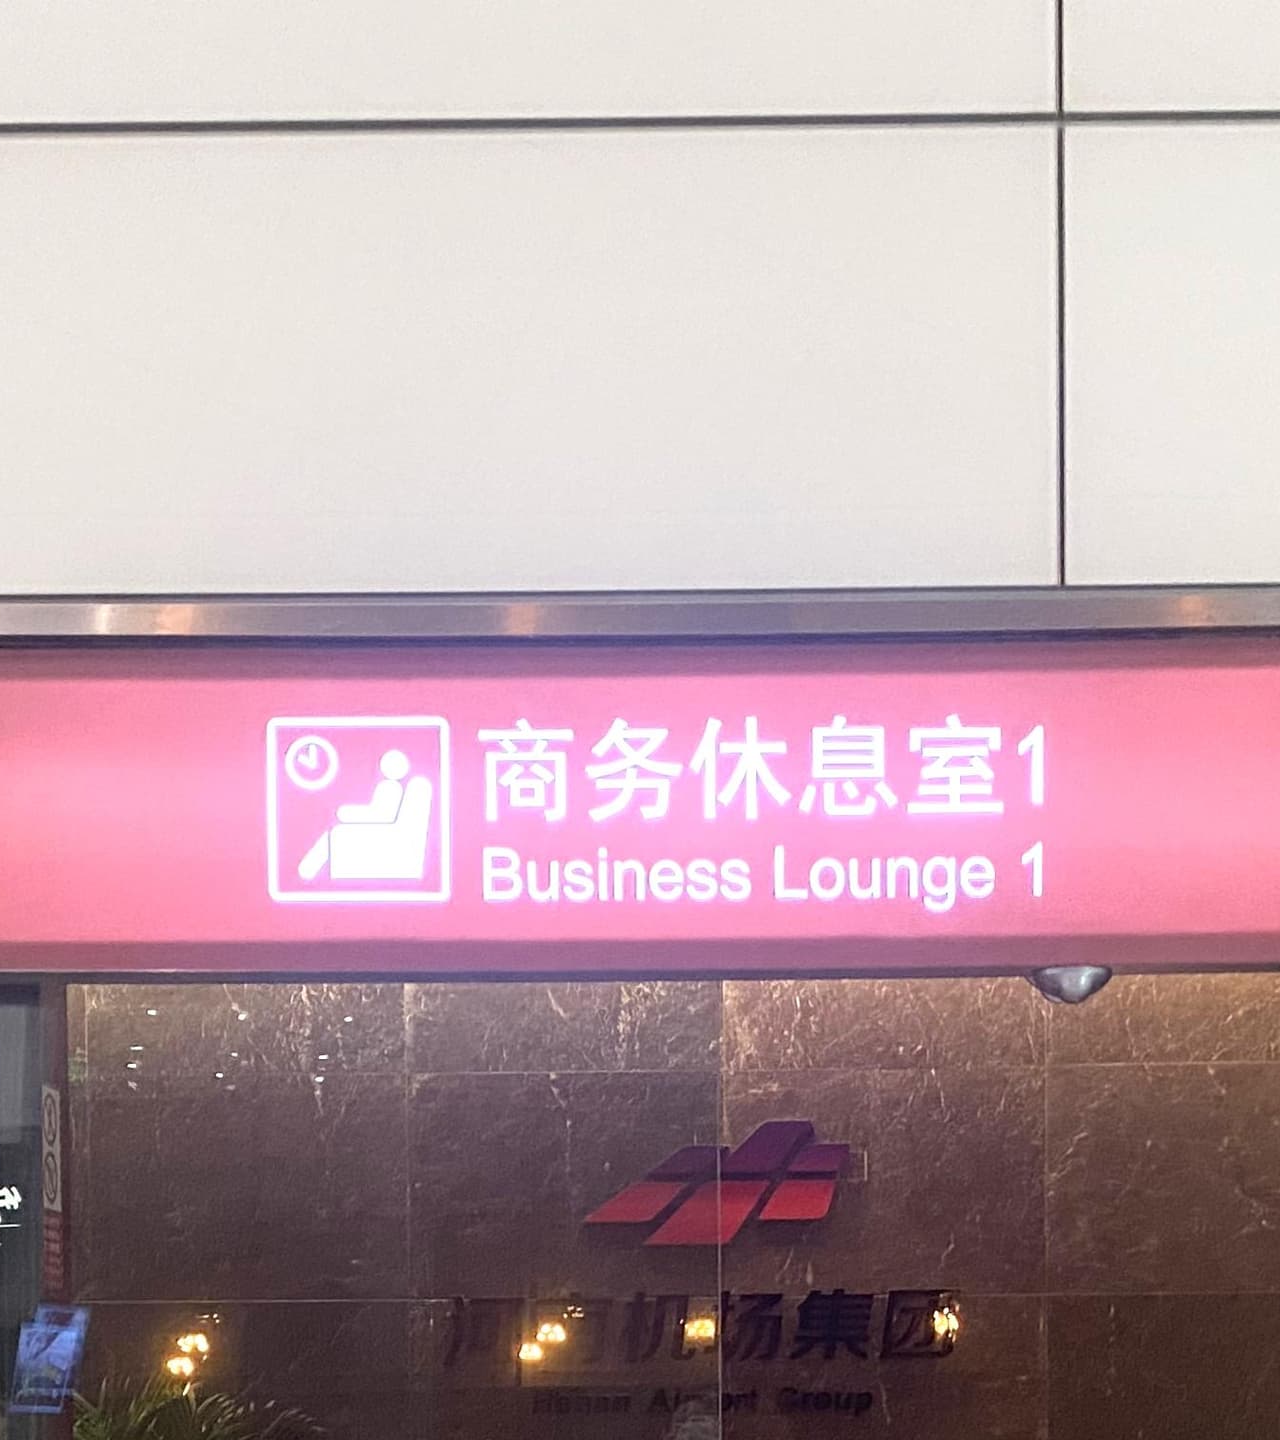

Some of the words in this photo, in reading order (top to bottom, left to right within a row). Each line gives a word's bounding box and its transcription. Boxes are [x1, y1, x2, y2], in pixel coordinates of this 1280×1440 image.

[476, 714, 1047, 823] 商务休息室1
[481, 846, 753, 903] Business
[773, 845, 996, 912] Lounge
[1021, 842, 1045, 897] 1
